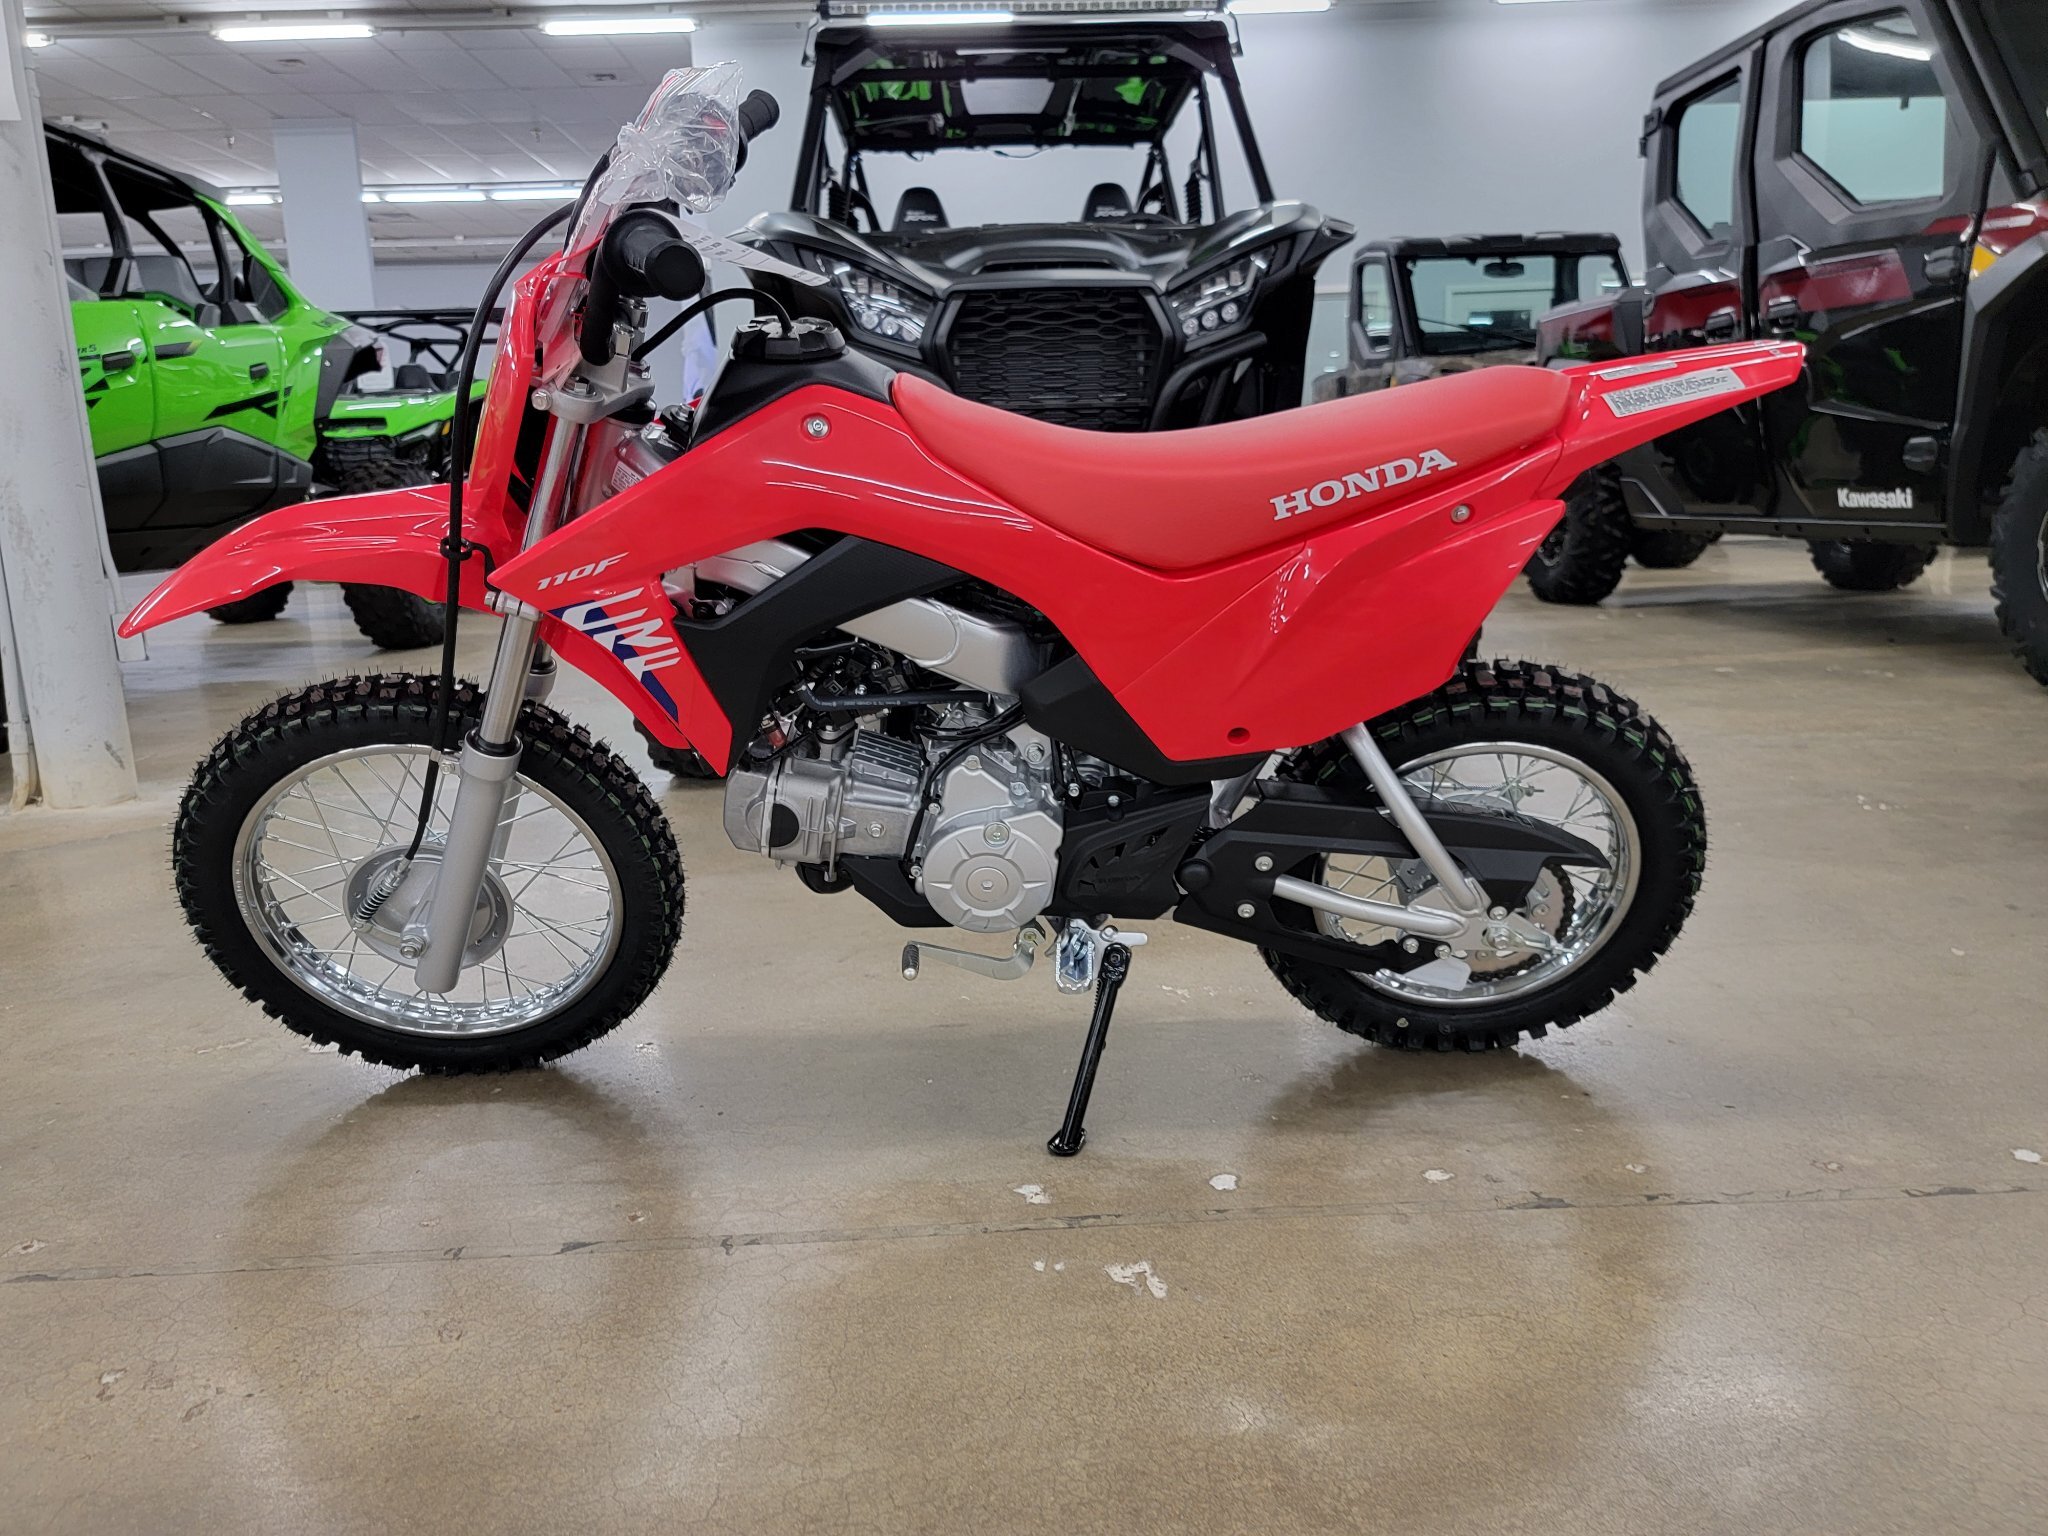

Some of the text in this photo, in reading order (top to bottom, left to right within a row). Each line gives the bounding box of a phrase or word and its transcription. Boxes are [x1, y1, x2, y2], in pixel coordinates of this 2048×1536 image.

[1270, 448, 1458, 521] HONDA
[1837, 487, 1913, 508] Kawasaki
[537, 552, 630, 591] 110F
